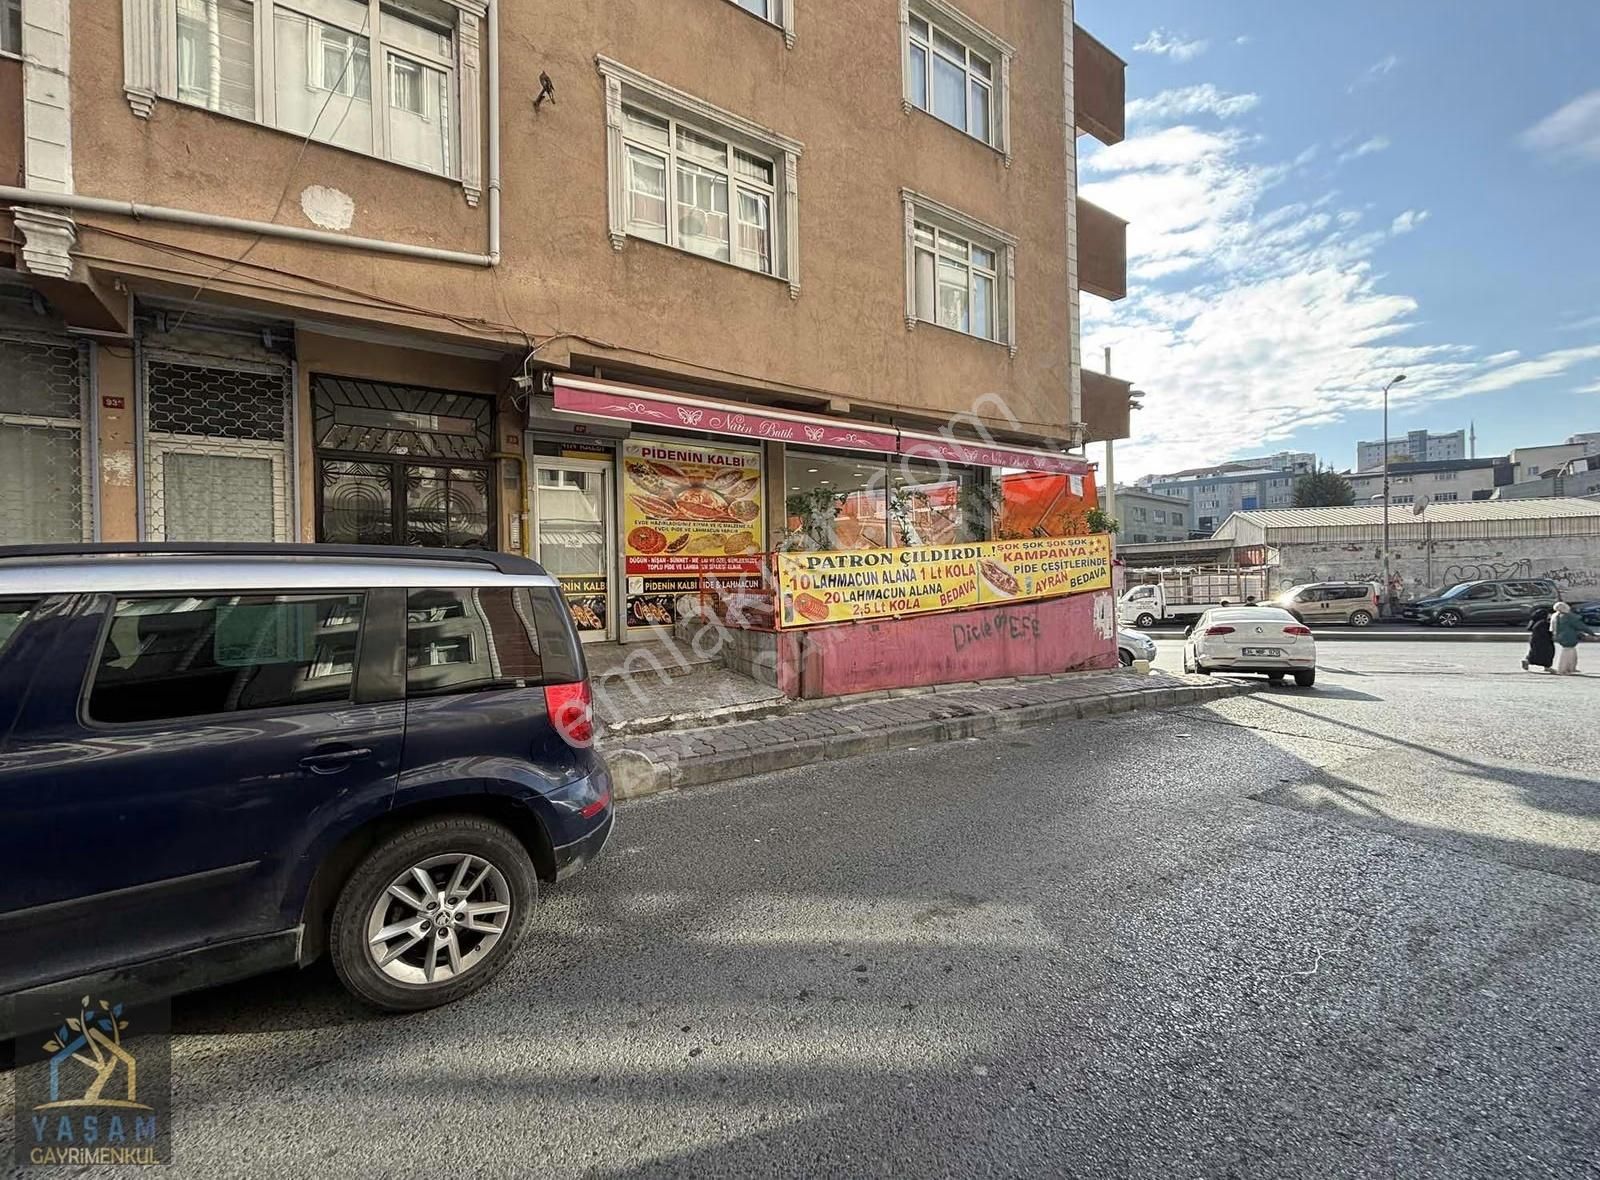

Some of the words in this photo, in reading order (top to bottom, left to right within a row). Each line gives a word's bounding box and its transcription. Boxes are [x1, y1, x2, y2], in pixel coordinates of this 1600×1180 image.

[709, 413, 753, 434] Narin
[759, 420, 794, 439] Butik
[641, 446, 702, 463] PİDENİN
[707, 454, 745, 467] KALBİ
[1022, 541, 1044, 550] ŞOK
[1068, 538, 1087, 547] ŞOK
[806, 552, 893, 570] PATRON
[1003, 547, 1087, 562] KAMPANYA
[1014, 563, 1038, 574] PİDE
[1041, 557, 1107, 573] ÇEŞİTLERİNDE
[583, 580, 606, 590] KALB
[645, 579, 676, 591] PİDENİN
[790, 574, 810, 590] 10
[812, 571, 878, 589] LAHMACUN
[882, 568, 917, 584] ALANA
[920, 567, 926, 580] 1
[930, 566, 942, 579] Lt
[945, 563, 976, 578] KOLA
[1035, 571, 1069, 594] AYRAN
[1070, 567, 1107, 588] BEDAVA
[824, 591, 840, 605] 20
[842, 587, 906, 602] LAHMACUN
[909, 583, 943, 597] ALANA
[853, 603, 871, 616] 2,5
[874, 602, 885, 613] Lt
[889, 598, 920, 612] KOLA
[940, 580, 977, 606] BEDAVA
